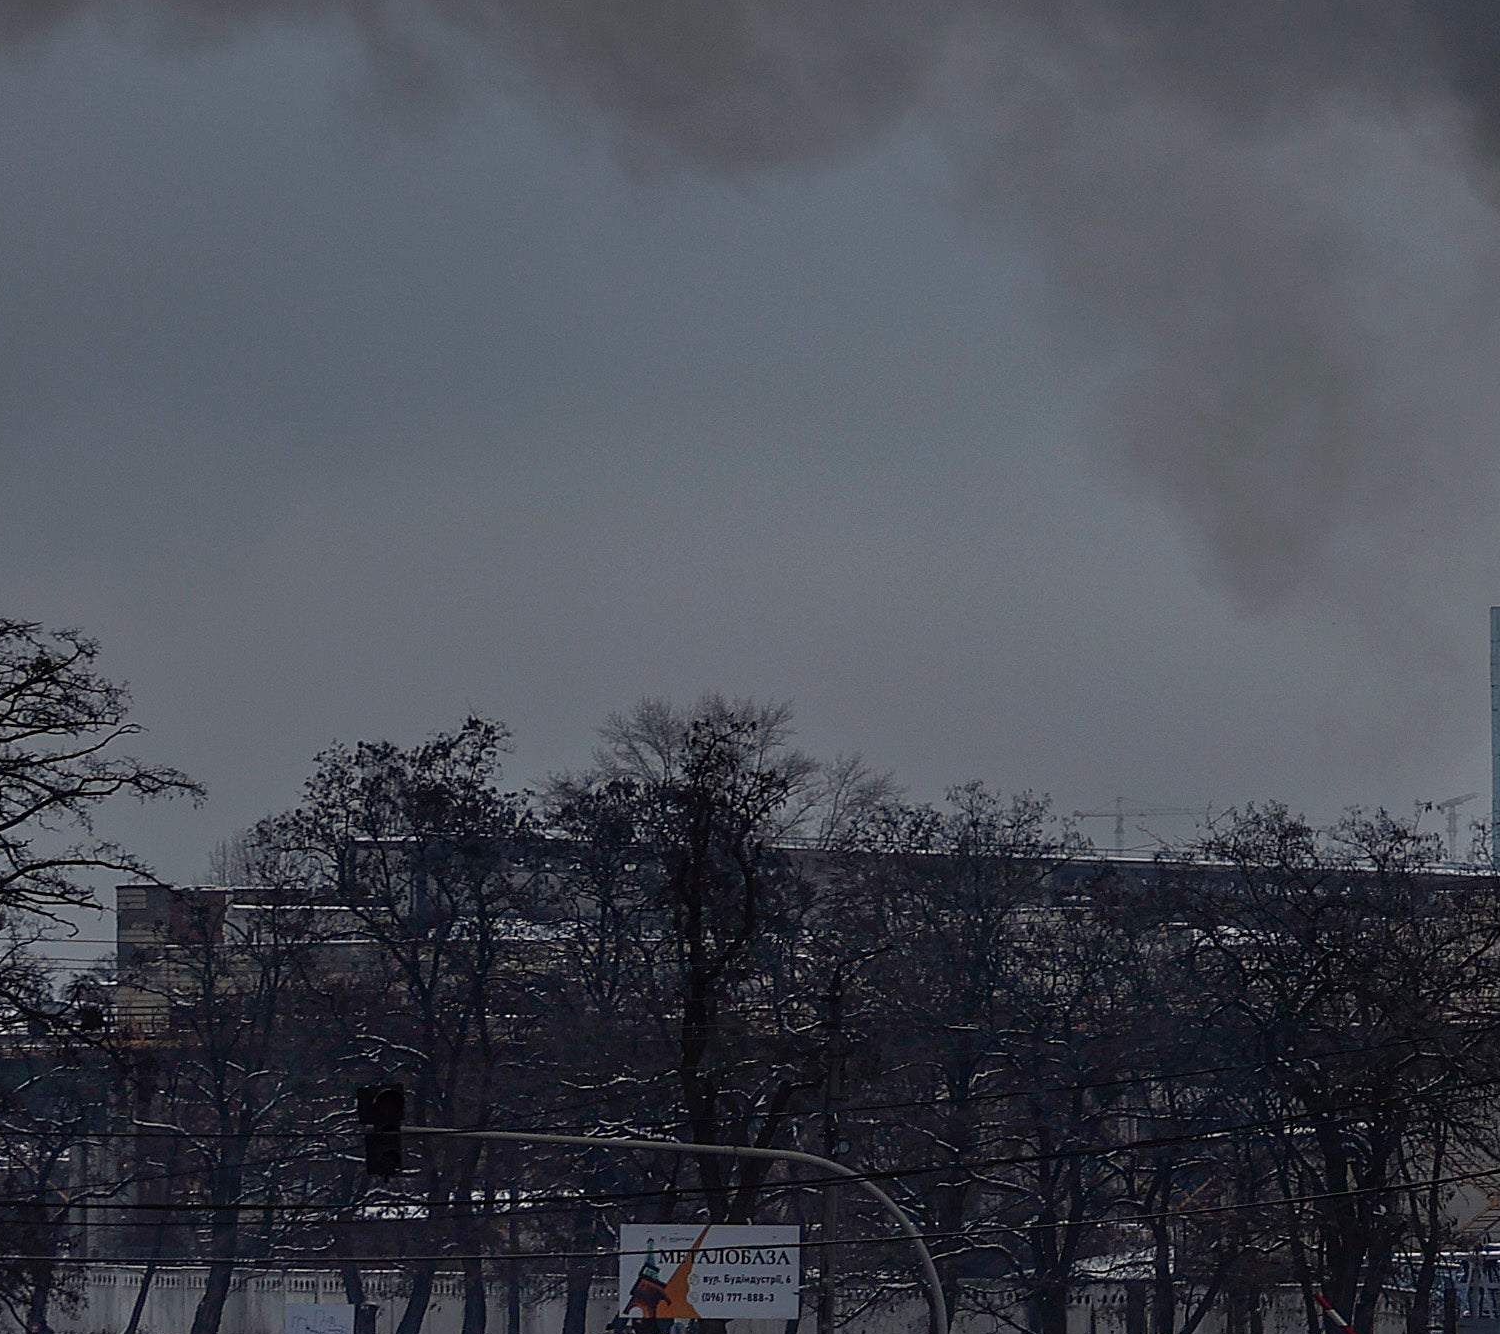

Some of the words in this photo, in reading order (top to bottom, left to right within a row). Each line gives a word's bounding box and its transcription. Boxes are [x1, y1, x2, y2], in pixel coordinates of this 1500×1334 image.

[658, 1248, 791, 1265] МЕТАЛОБАЗА
[785, 1275, 792, 1284] 6
[701, 1293, 724, 1303] (096)
[726, 1293, 775, 1303] 777-888-3
